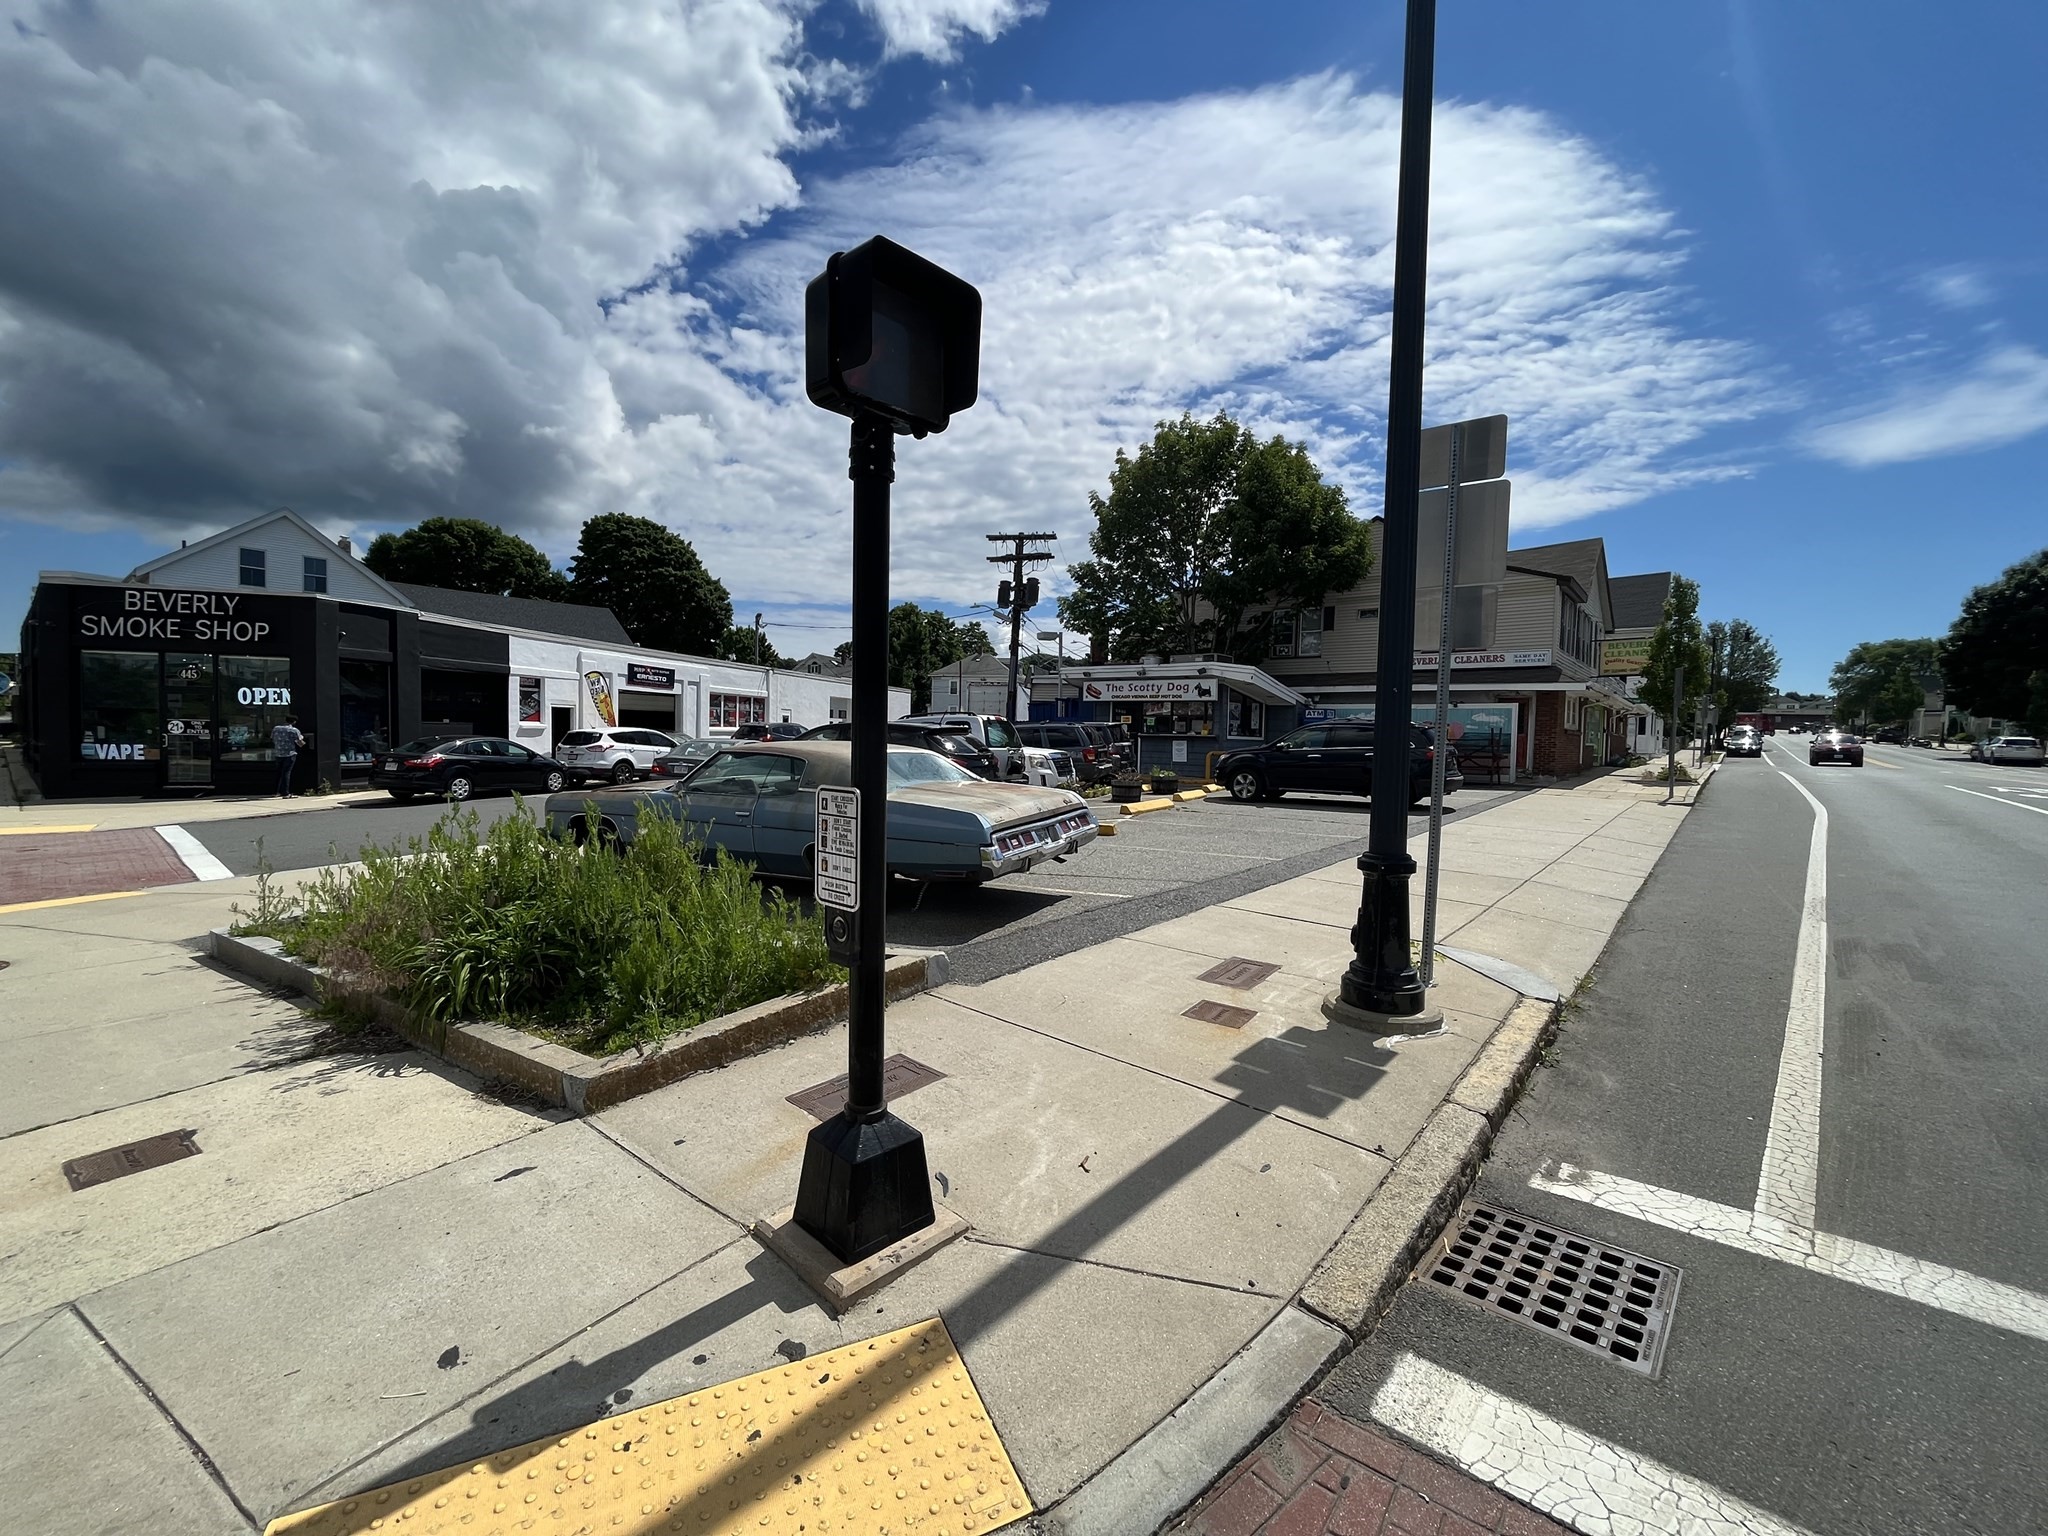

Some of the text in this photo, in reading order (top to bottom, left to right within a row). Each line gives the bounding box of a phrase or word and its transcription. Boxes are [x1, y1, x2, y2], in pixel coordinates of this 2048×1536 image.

[125, 590, 239, 615] BEVERLY
[81, 615, 270, 641] SMOKE SHOP
[1608, 641, 1649, 649] BEVERL
[1413, 654, 1505, 665] EVERL CLEANERS
[180, 670, 198, 679] 445
[637, 673, 667, 682] ERNESTO
[1106, 682, 1189, 693] The Scotty Dog
[95, 744, 145, 760] VAPE
